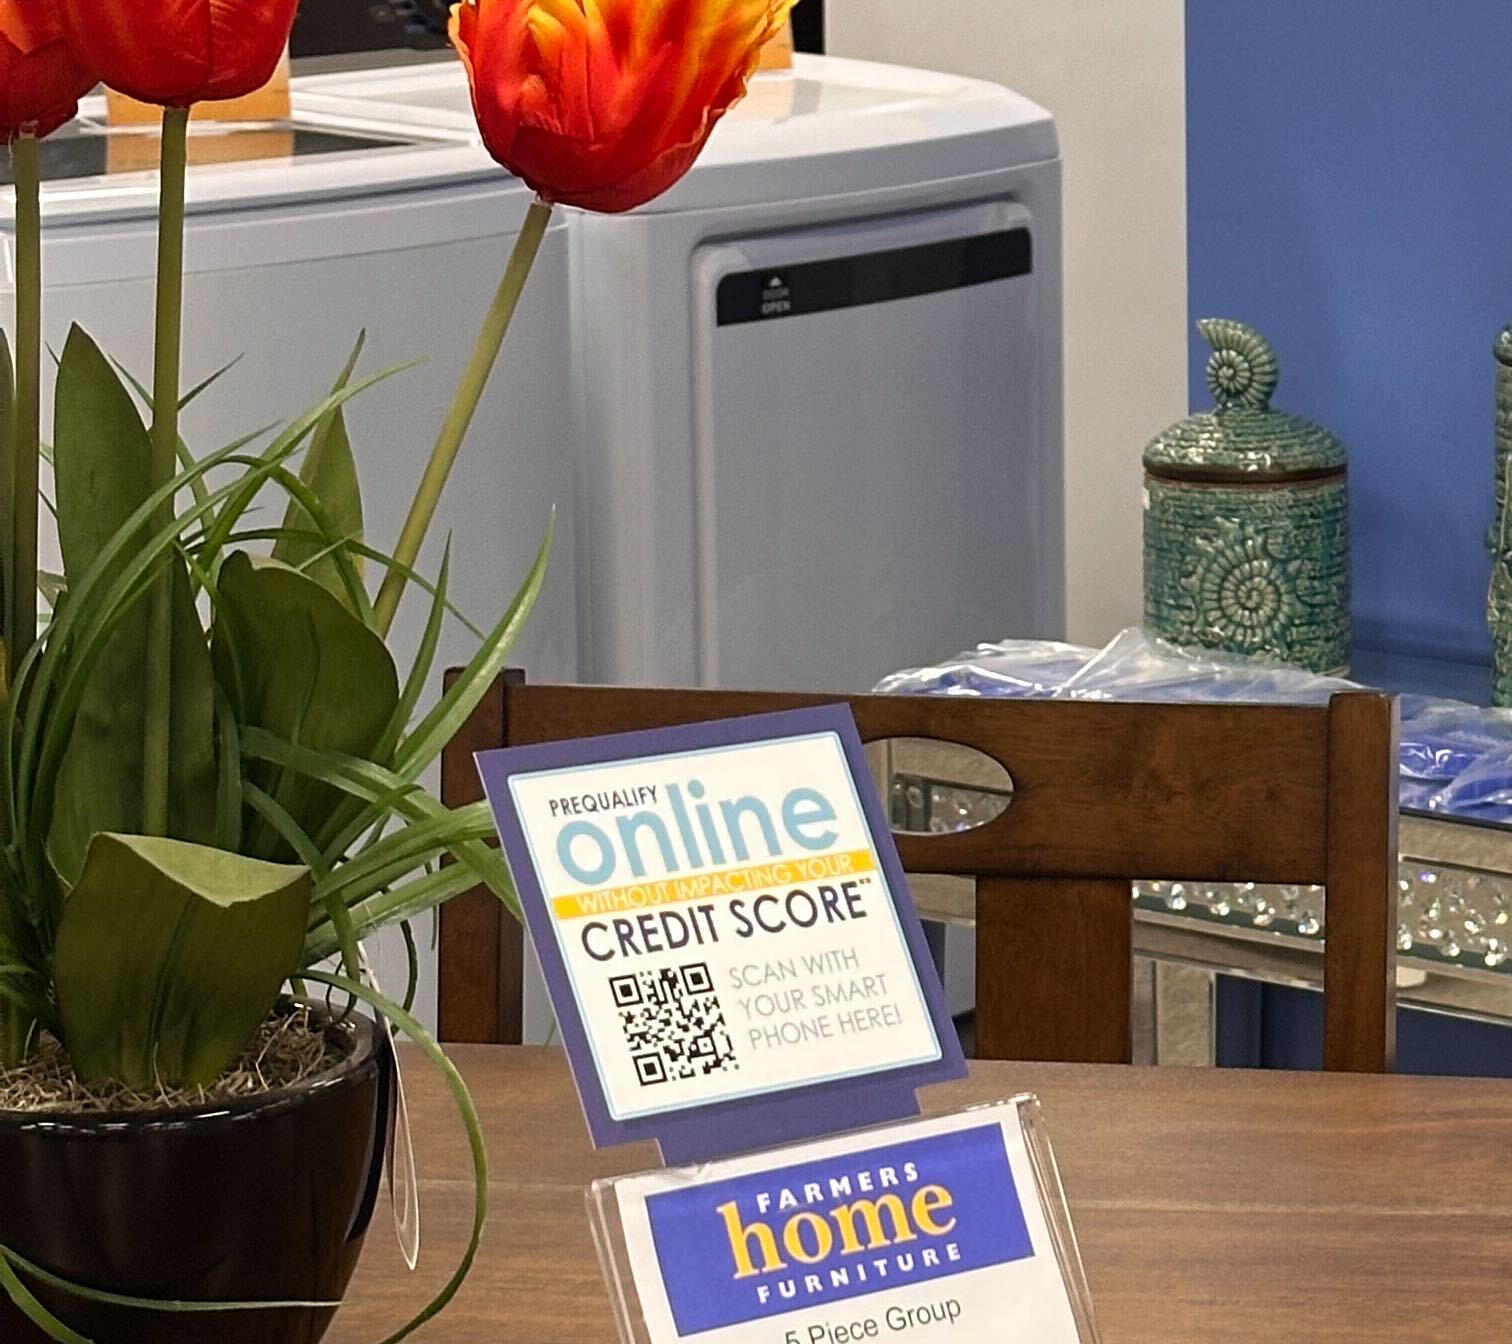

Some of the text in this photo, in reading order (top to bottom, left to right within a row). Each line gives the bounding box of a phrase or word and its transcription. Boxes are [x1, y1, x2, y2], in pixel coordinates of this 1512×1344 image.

[548, 784, 660, 817] PREQUALIFY
[555, 778, 839, 886] online
[575, 853, 855, 915] WITHOUT IMPACTING YOUR
[581, 903, 720, 962] CREDIT
[728, 947, 861, 991] SCAN WITH
[738, 973, 889, 1021] YOUR SMART
[748, 1003, 904, 1051] PHONE HERE!
[756, 1161, 920, 1214] FARMERS
[716, 1182, 957, 1280] home
[756, 1241, 963, 1304] FURNITURE
[884, 1295, 963, 1334] Group
